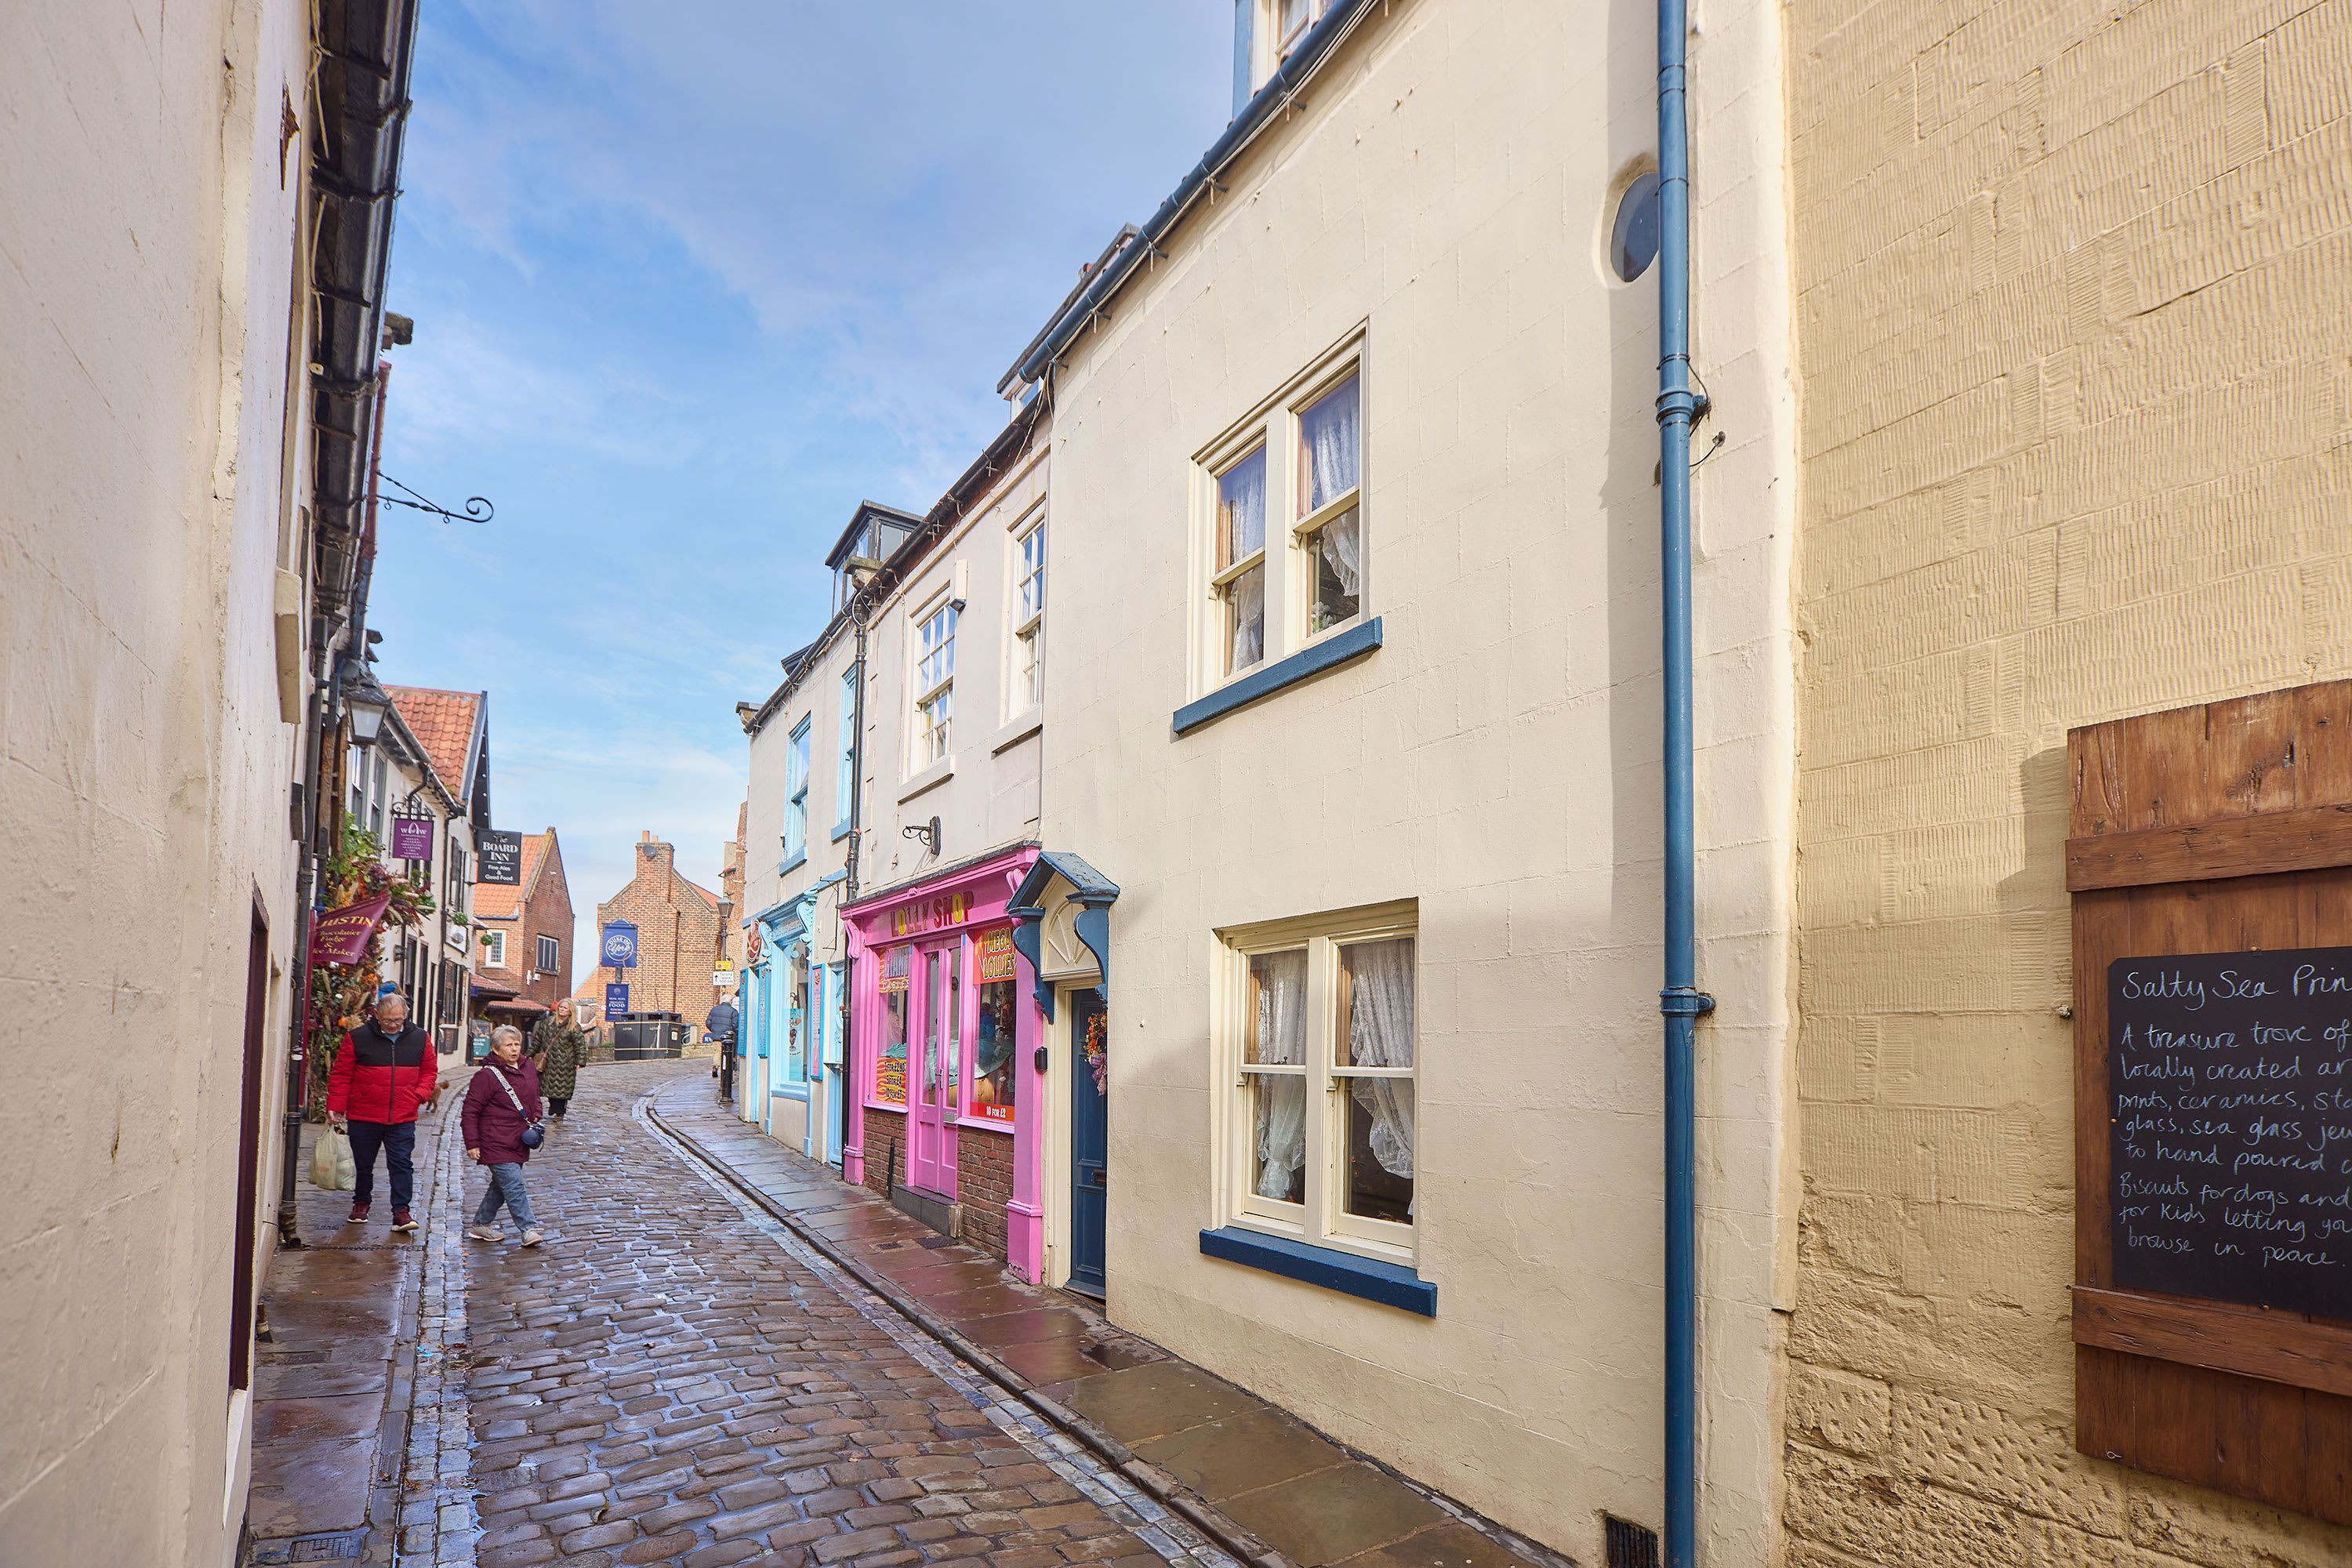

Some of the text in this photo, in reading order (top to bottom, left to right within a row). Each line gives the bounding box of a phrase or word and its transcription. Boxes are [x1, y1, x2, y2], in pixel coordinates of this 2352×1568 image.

[482, 841, 518, 853] BOARD
[490, 851, 510, 862] INN
[316, 916, 375, 928] JUSTIN
[891, 891, 975, 938] LOLLY SHOP
[326, 948, 356, 956] Maker
[608, 937, 623, 946] DUKE
[988, 927, 1012, 953] MEGA
[983, 953, 1015, 979] LOLLIES
[2122, 964, 2352, 1011] Salty Sea Prin
[2122, 1019, 2352, 1052] A treasure trove of
[2121, 1053, 2195, 1091] locally
[2206, 1055, 2303, 1080] created
[986, 1105, 991, 1116] 10
[1000, 1108, 1006, 1118] £2
[2118, 1091, 2172, 1117] prints,
[2119, 1114, 2183, 1142] glass,
[2189, 1120, 2238, 1135] sea
[2243, 1116, 2303, 1145] glass
[2125, 1142, 2146, 1158] to
[2157, 1140, 2224, 1165] hand
[2234, 1152, 2326, 1175] poured
[2120, 1171, 2352, 1215] Biscuits for dogs and
[2119, 1205, 2151, 1224] for
[2224, 1207, 2306, 1243] letting
[2128, 1225, 2194, 1254] browse
[2215, 1237, 2245, 1256] in
